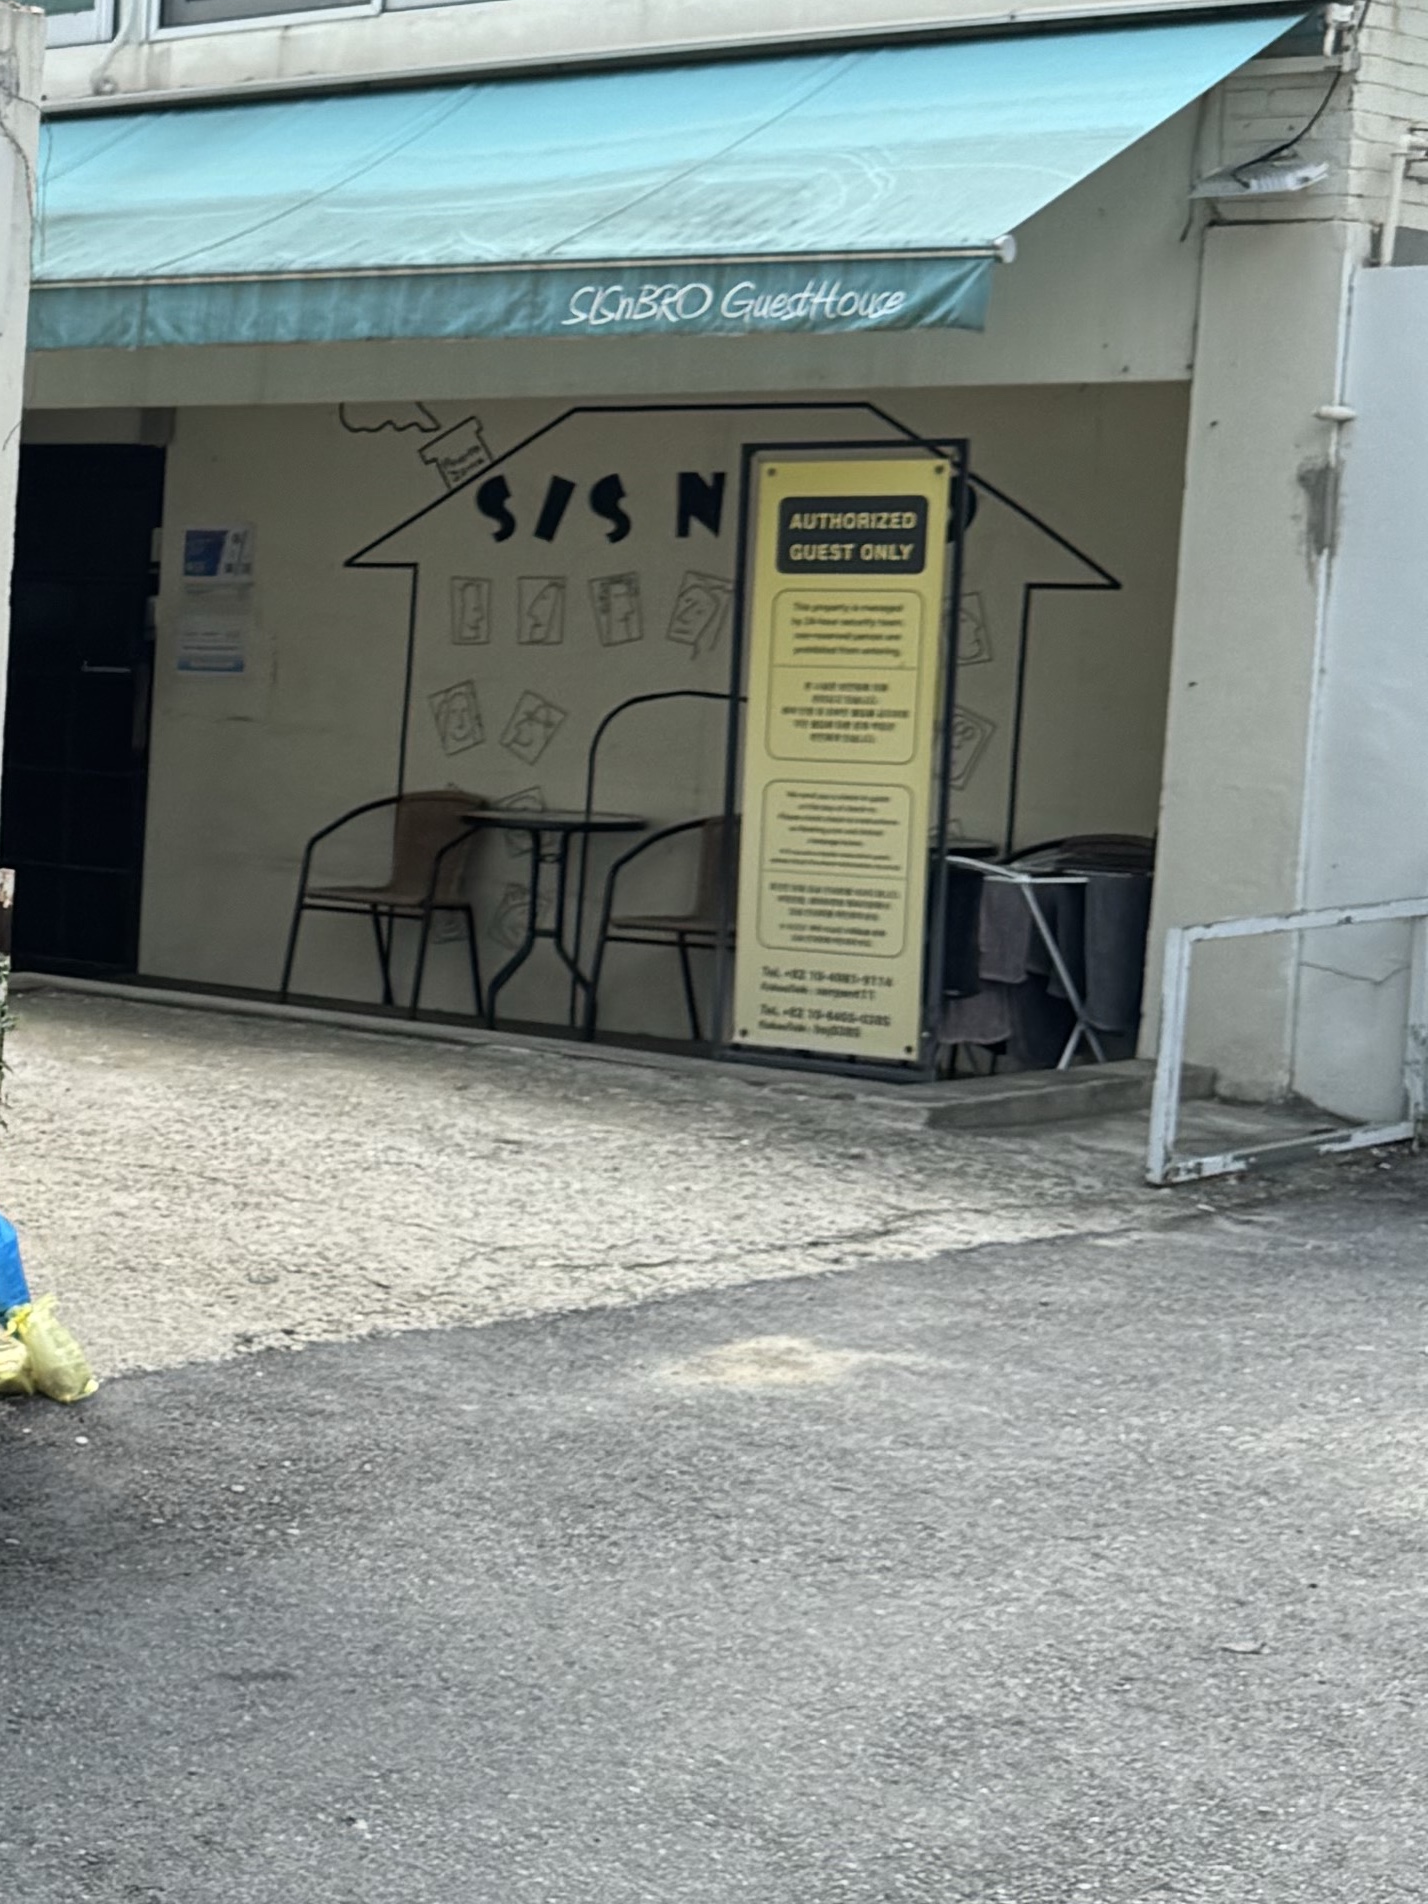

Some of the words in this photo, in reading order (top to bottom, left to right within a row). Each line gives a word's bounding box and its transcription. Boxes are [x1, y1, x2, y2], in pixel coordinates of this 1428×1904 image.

[720, 279, 906, 322] GuestHouse
[789, 512, 917, 529] AUTHORIZED
[789, 543, 854, 561] GUEST
[859, 543, 914, 561] ONLY
